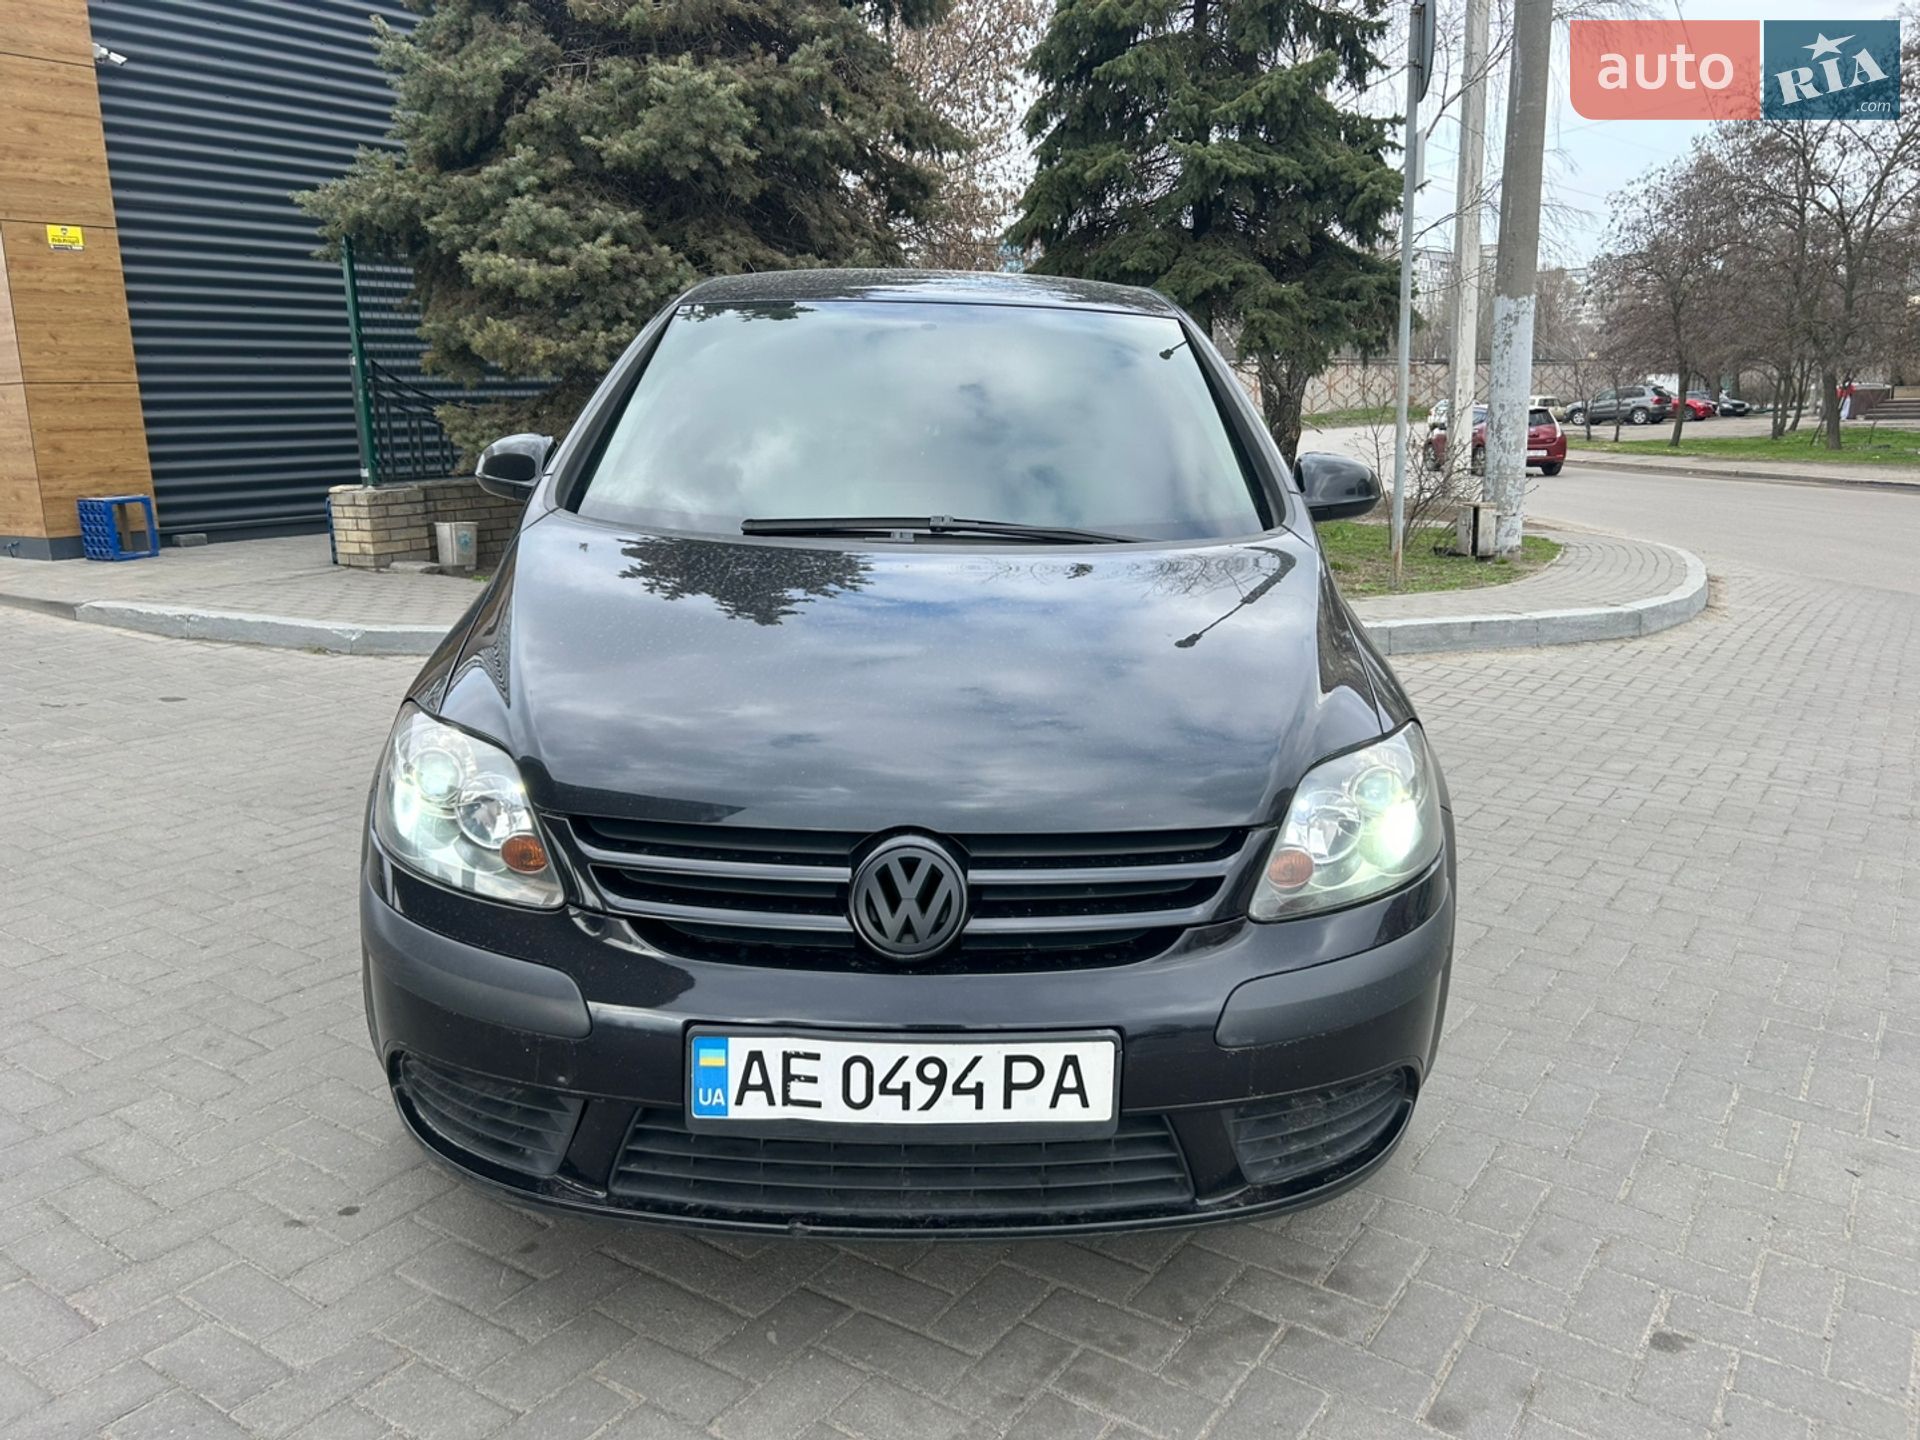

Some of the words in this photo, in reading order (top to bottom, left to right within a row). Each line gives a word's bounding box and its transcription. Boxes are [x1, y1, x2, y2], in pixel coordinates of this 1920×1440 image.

[700, 1087, 725, 1106] UA
[734, 1050, 822, 1108] AE
[842, 1055, 984, 1111] 0494
[1003, 1054, 1090, 1109] PA
